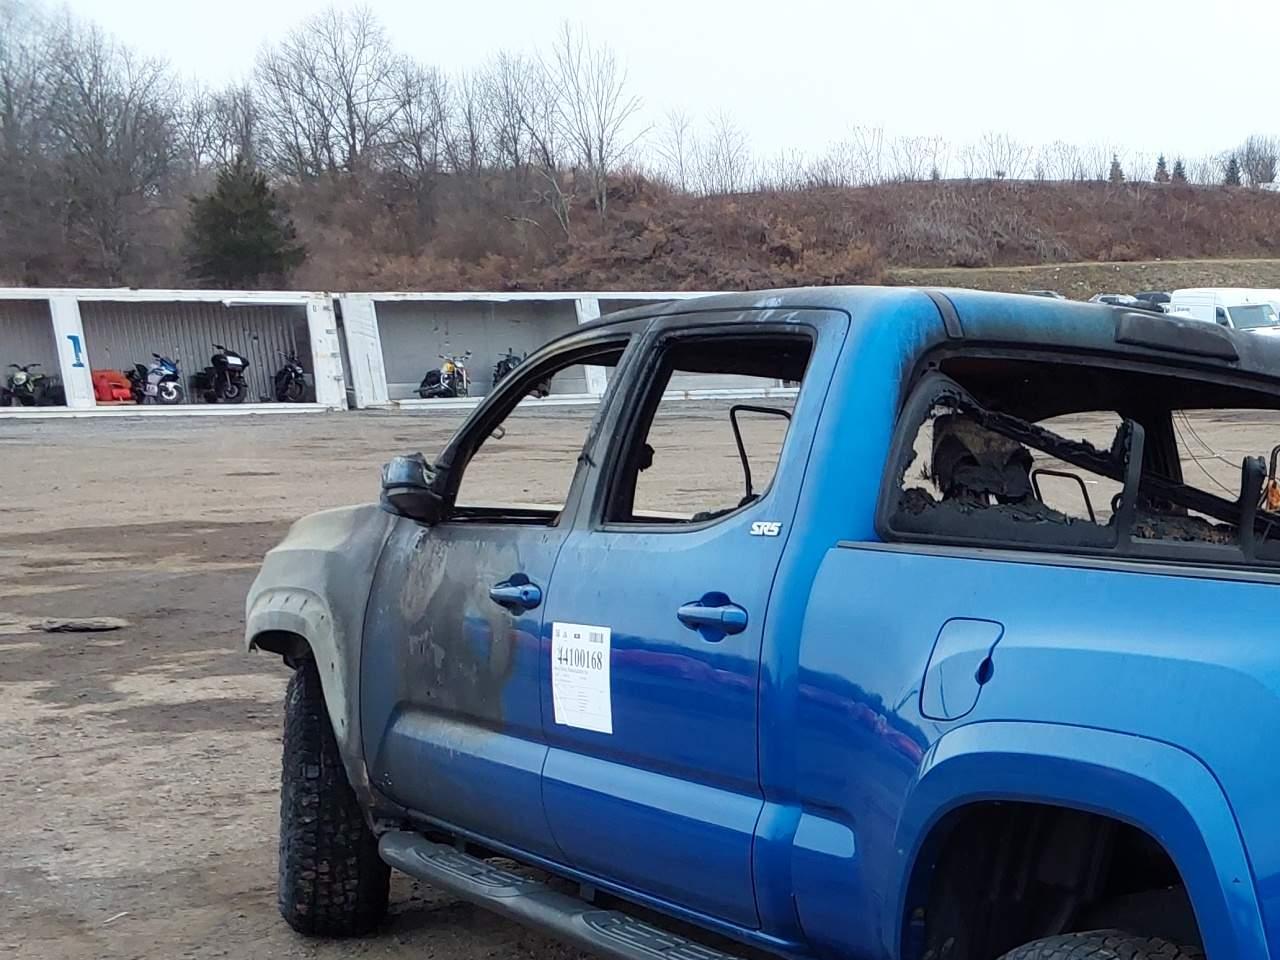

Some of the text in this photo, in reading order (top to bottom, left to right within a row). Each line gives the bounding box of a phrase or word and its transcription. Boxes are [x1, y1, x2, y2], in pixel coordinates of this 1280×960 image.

[66, 335, 85, 368] 1
[749, 521, 783, 537] SR5
[557, 646, 604, 671] 44100168
